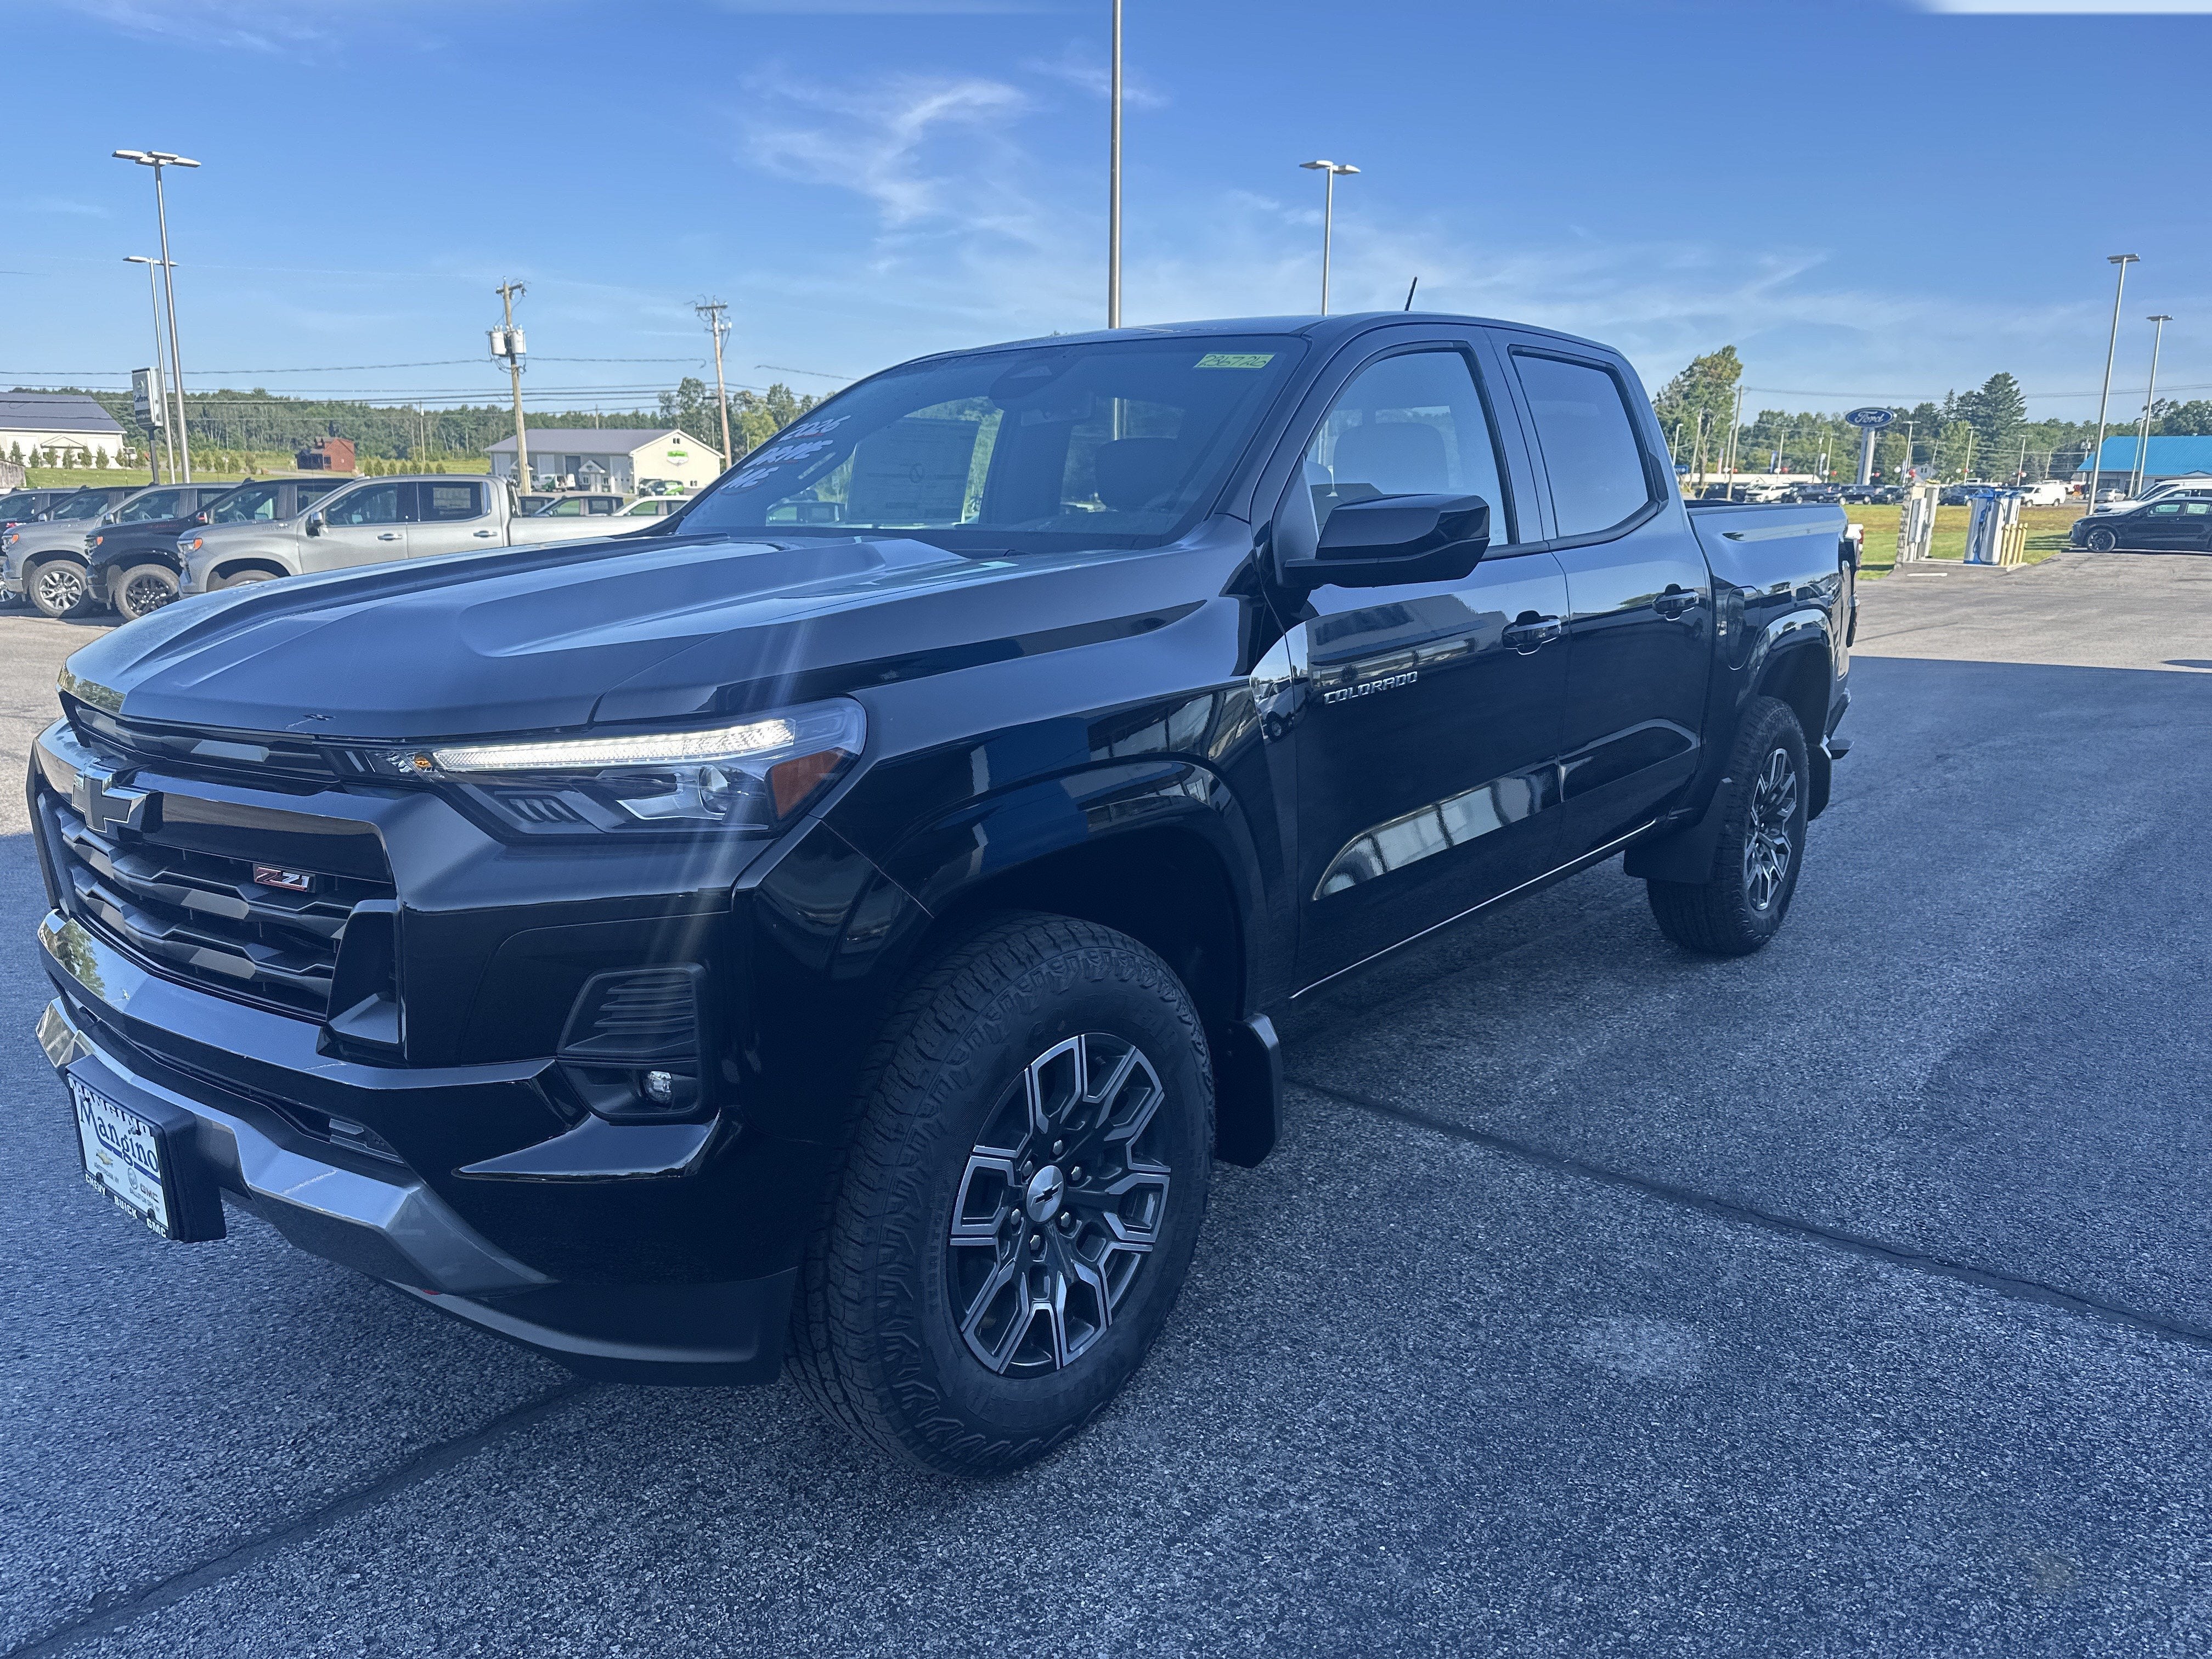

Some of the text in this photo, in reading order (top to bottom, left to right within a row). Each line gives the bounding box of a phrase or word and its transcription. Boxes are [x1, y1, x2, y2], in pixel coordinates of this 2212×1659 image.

[778, 415, 851, 442] 2026
[1855, 410, 1884, 423] Ford
[1324, 671, 1418, 705] COLORADO
[254, 866, 310, 893] Z71
[80, 1097, 160, 1173] Mangino
[85, 1173, 106, 1196] CHEVY
[139, 1183, 159, 1204] GMC
[114, 1194, 138, 1219] BUICK
[146, 1217, 167, 1238] GMC
